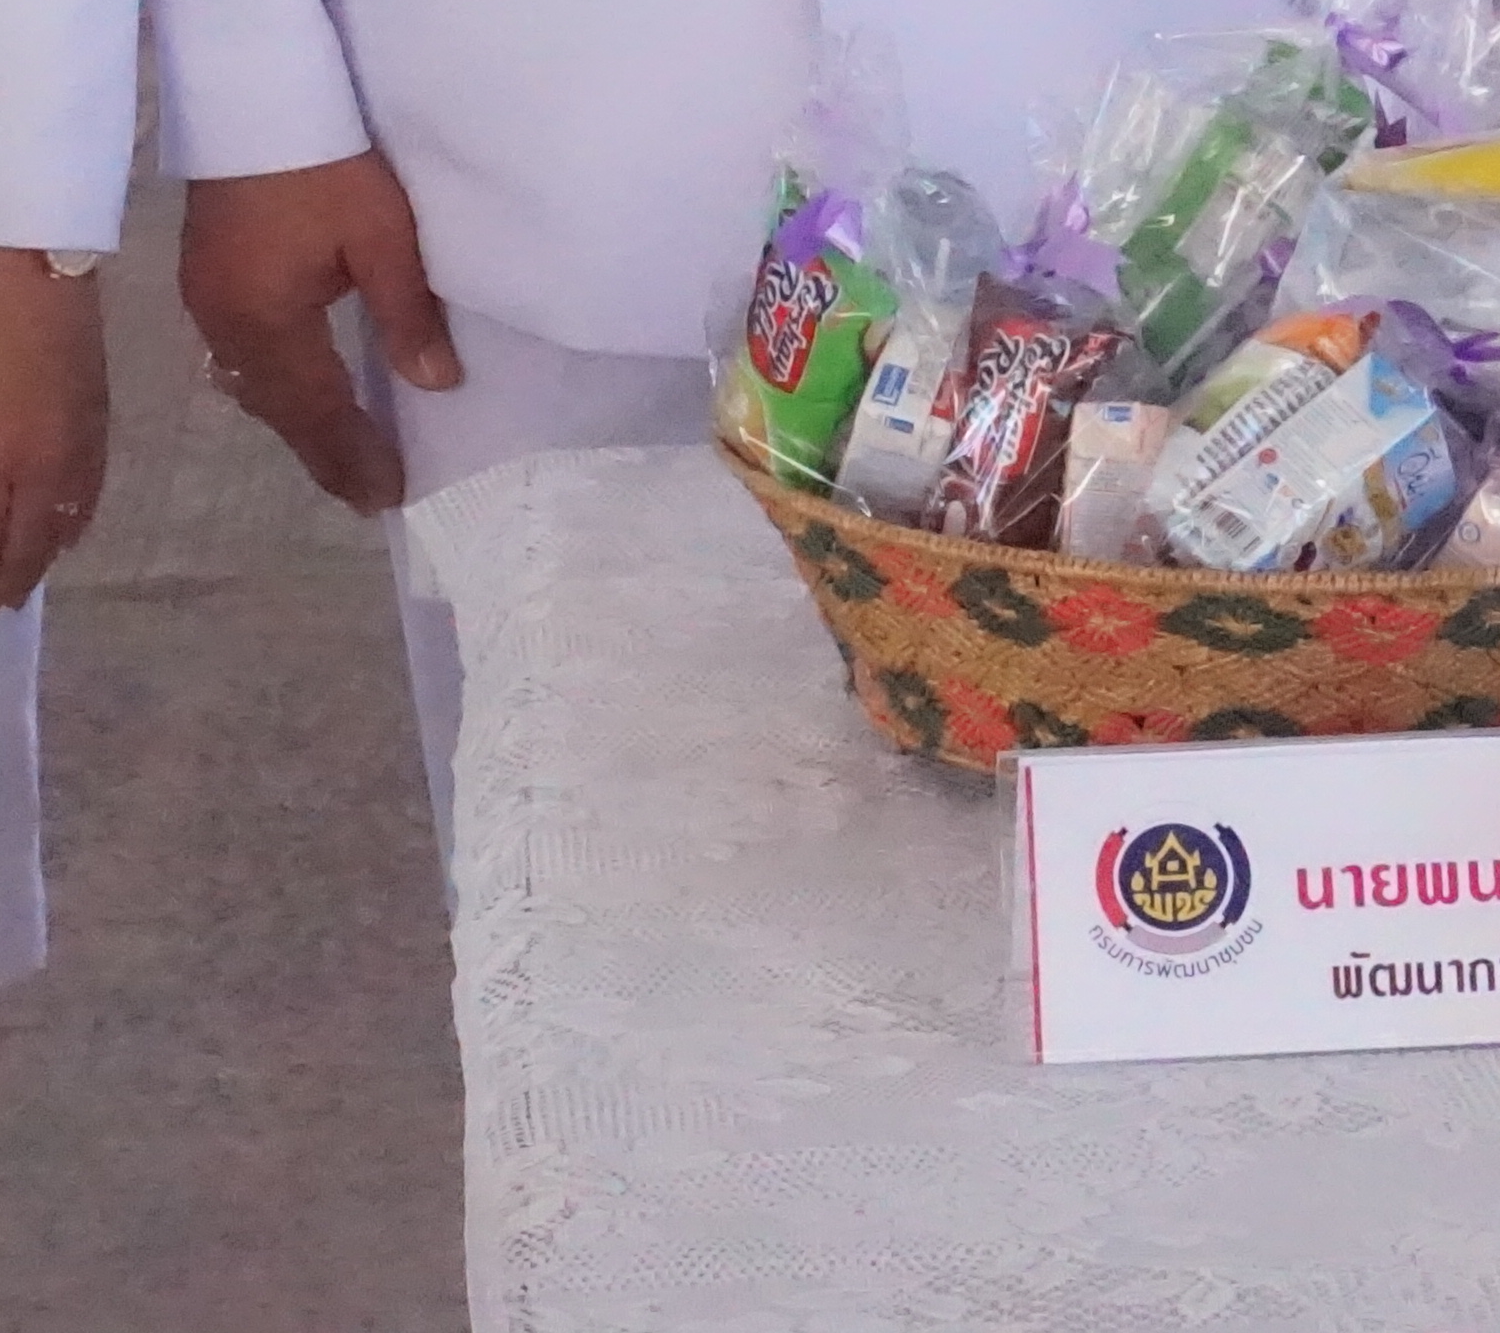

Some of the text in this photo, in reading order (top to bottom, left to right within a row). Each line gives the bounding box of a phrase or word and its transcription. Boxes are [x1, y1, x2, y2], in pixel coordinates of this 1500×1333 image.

[1089, 918, 1263, 979] กรมการพัฒนาชุมชน
